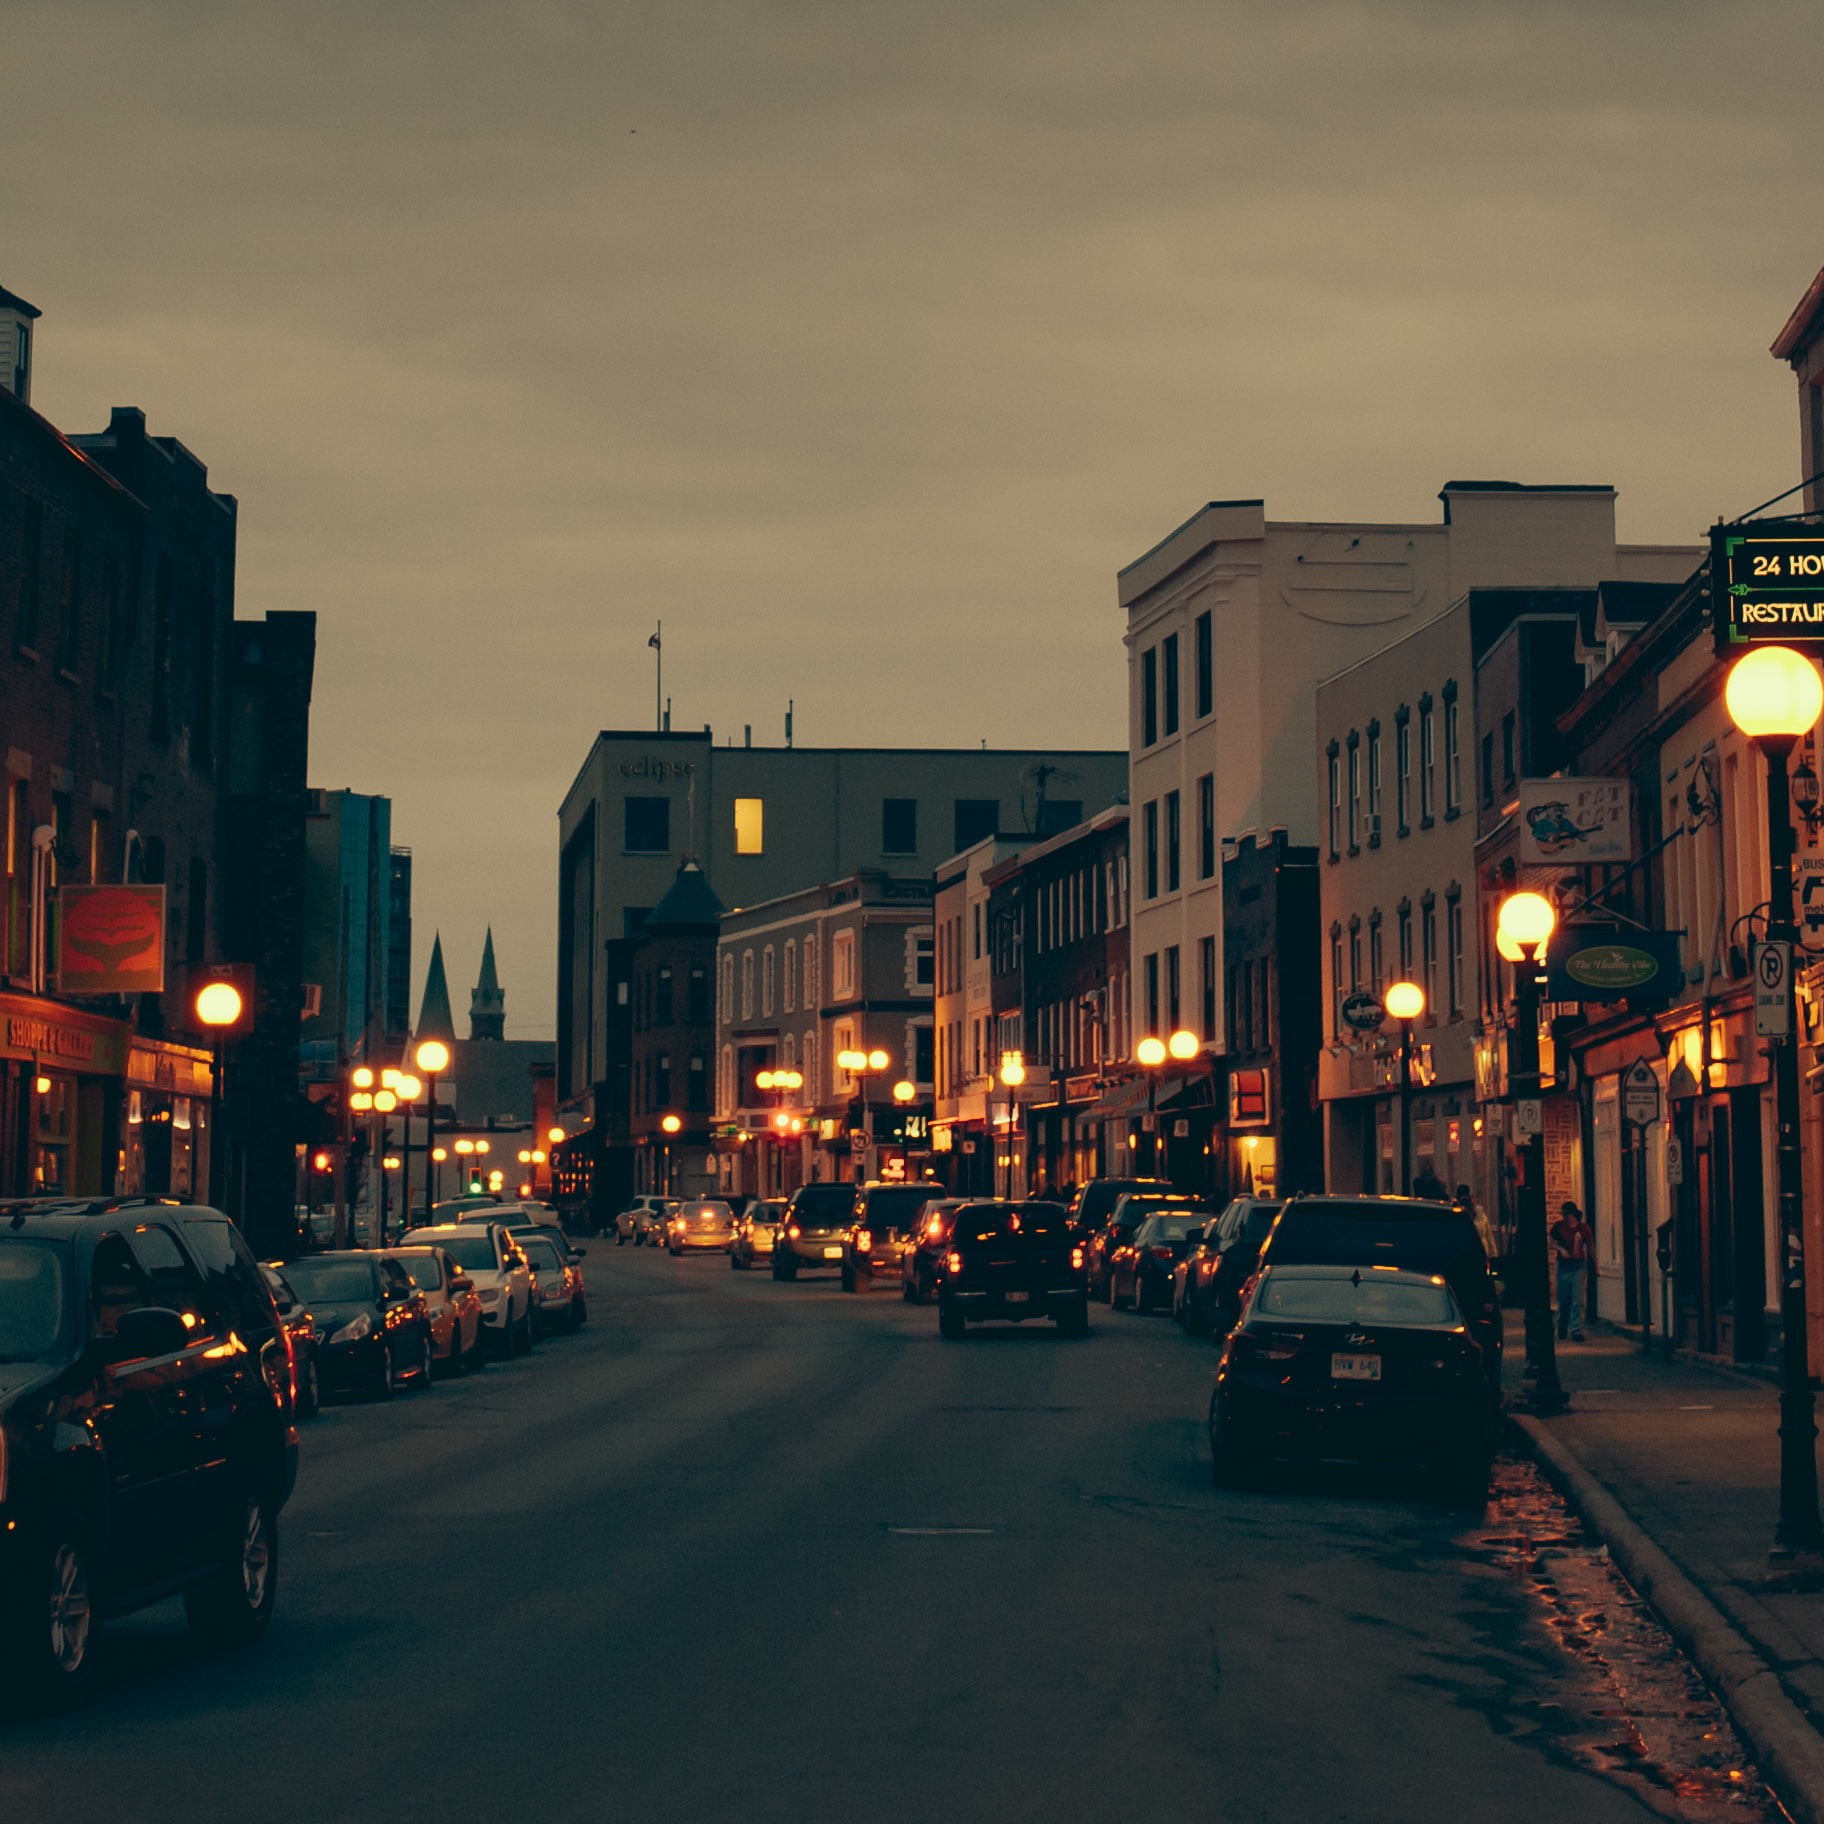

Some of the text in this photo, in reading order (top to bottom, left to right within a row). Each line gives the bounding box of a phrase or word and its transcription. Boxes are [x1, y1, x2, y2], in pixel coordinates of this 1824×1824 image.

[1753, 555, 1781, 576] 24
[619, 756, 695, 783] eclipse
[1803, 859, 1824, 869] BUS
